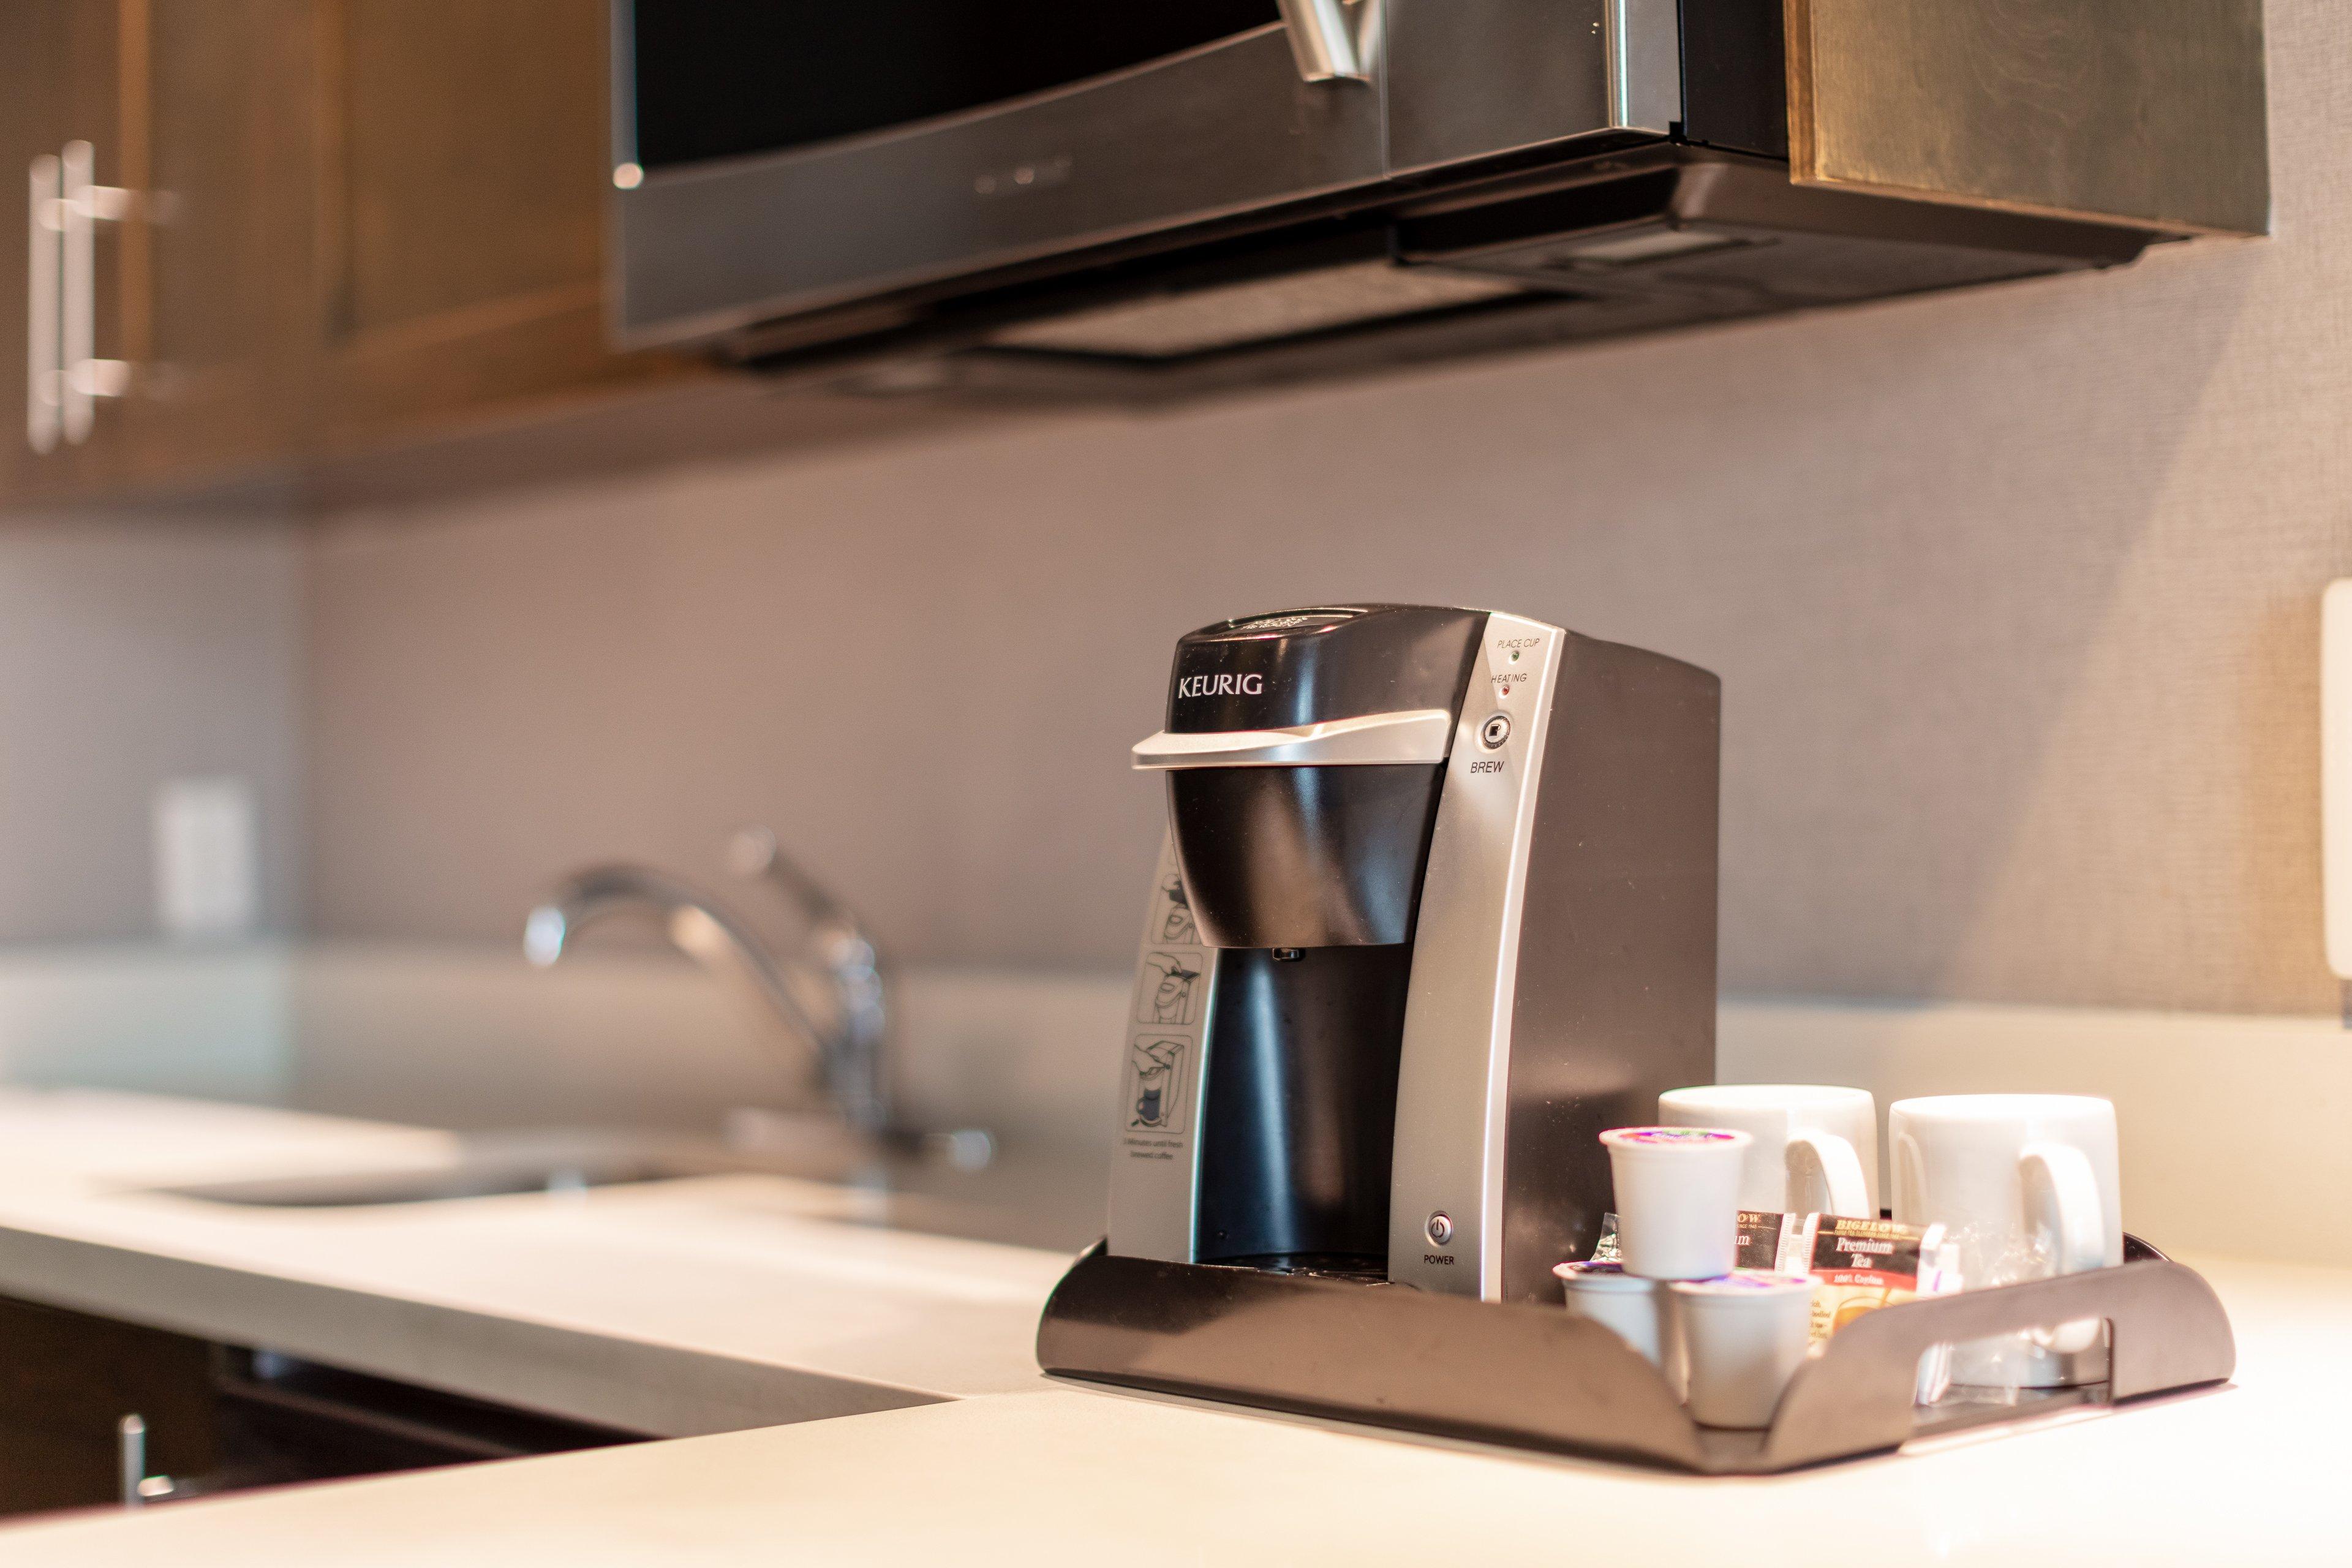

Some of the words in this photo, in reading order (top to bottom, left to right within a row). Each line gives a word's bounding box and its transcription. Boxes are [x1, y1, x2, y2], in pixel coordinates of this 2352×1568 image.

[1497, 639, 1522, 649] PLACE
[1523, 638, 1540, 647] CUP
[1490, 673, 1528, 684] HEATING
[1178, 674, 1263, 699] KEURIG
[1470, 761, 1505, 774] BREW
[1154, 1151, 1174, 1160] coffee
[1835, 1219, 1906, 1234] BIGELOW
[1836, 1237, 1894, 1254] Premium
[1423, 1254, 1455, 1265] POWER
[1850, 1253, 1872, 1268] Tea
